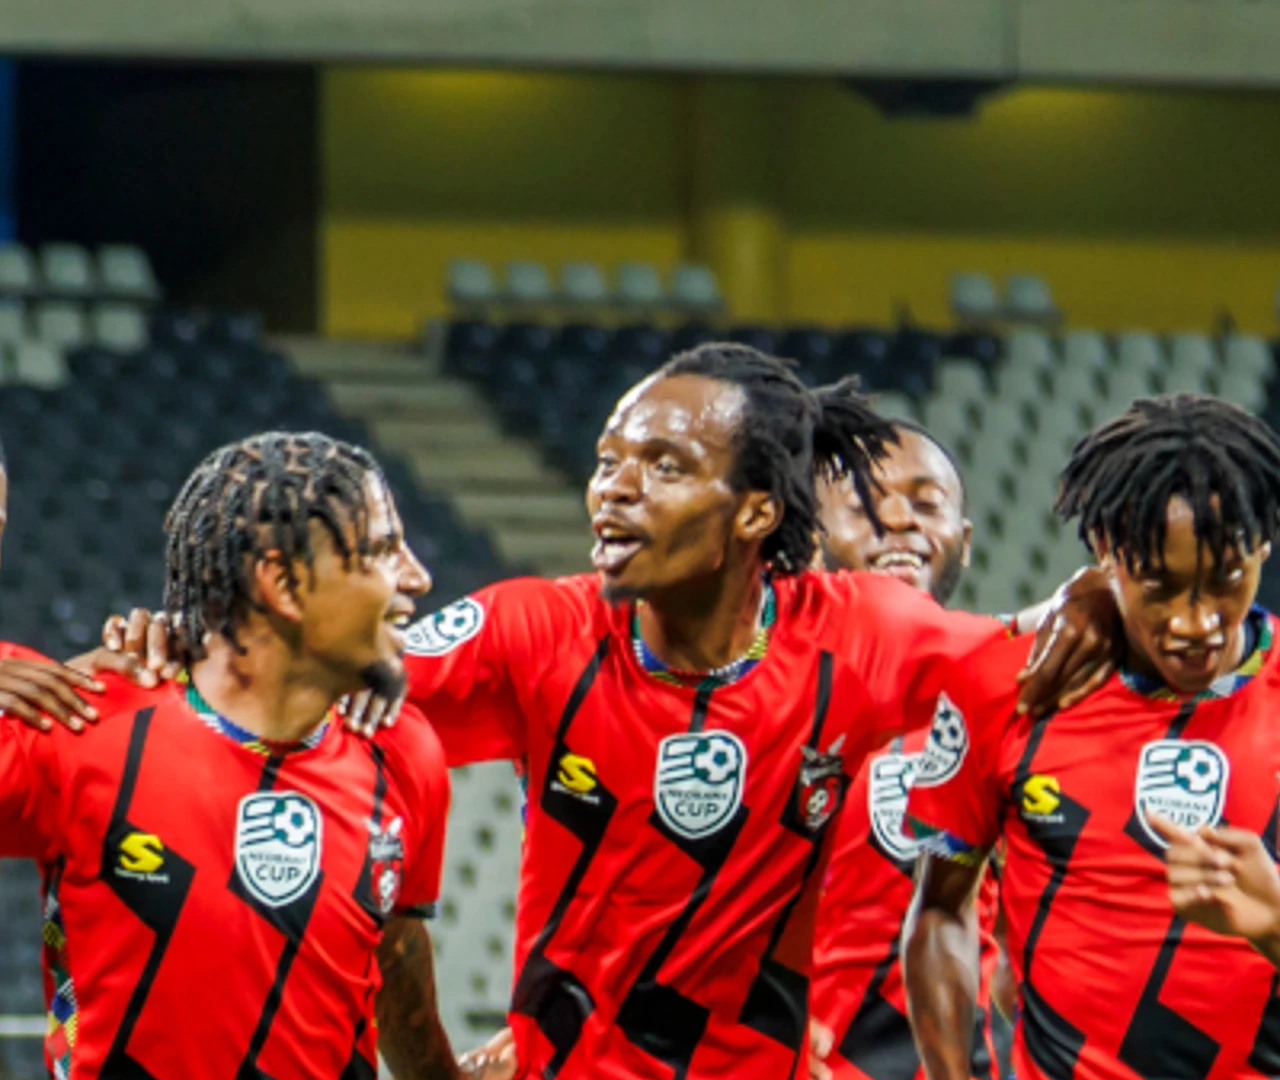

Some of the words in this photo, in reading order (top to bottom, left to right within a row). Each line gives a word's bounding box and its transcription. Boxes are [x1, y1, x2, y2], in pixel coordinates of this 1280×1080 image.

[674, 802, 719, 818] CUP
[1157, 809, 1200, 827] UP
[255, 865, 301, 882] CUP
